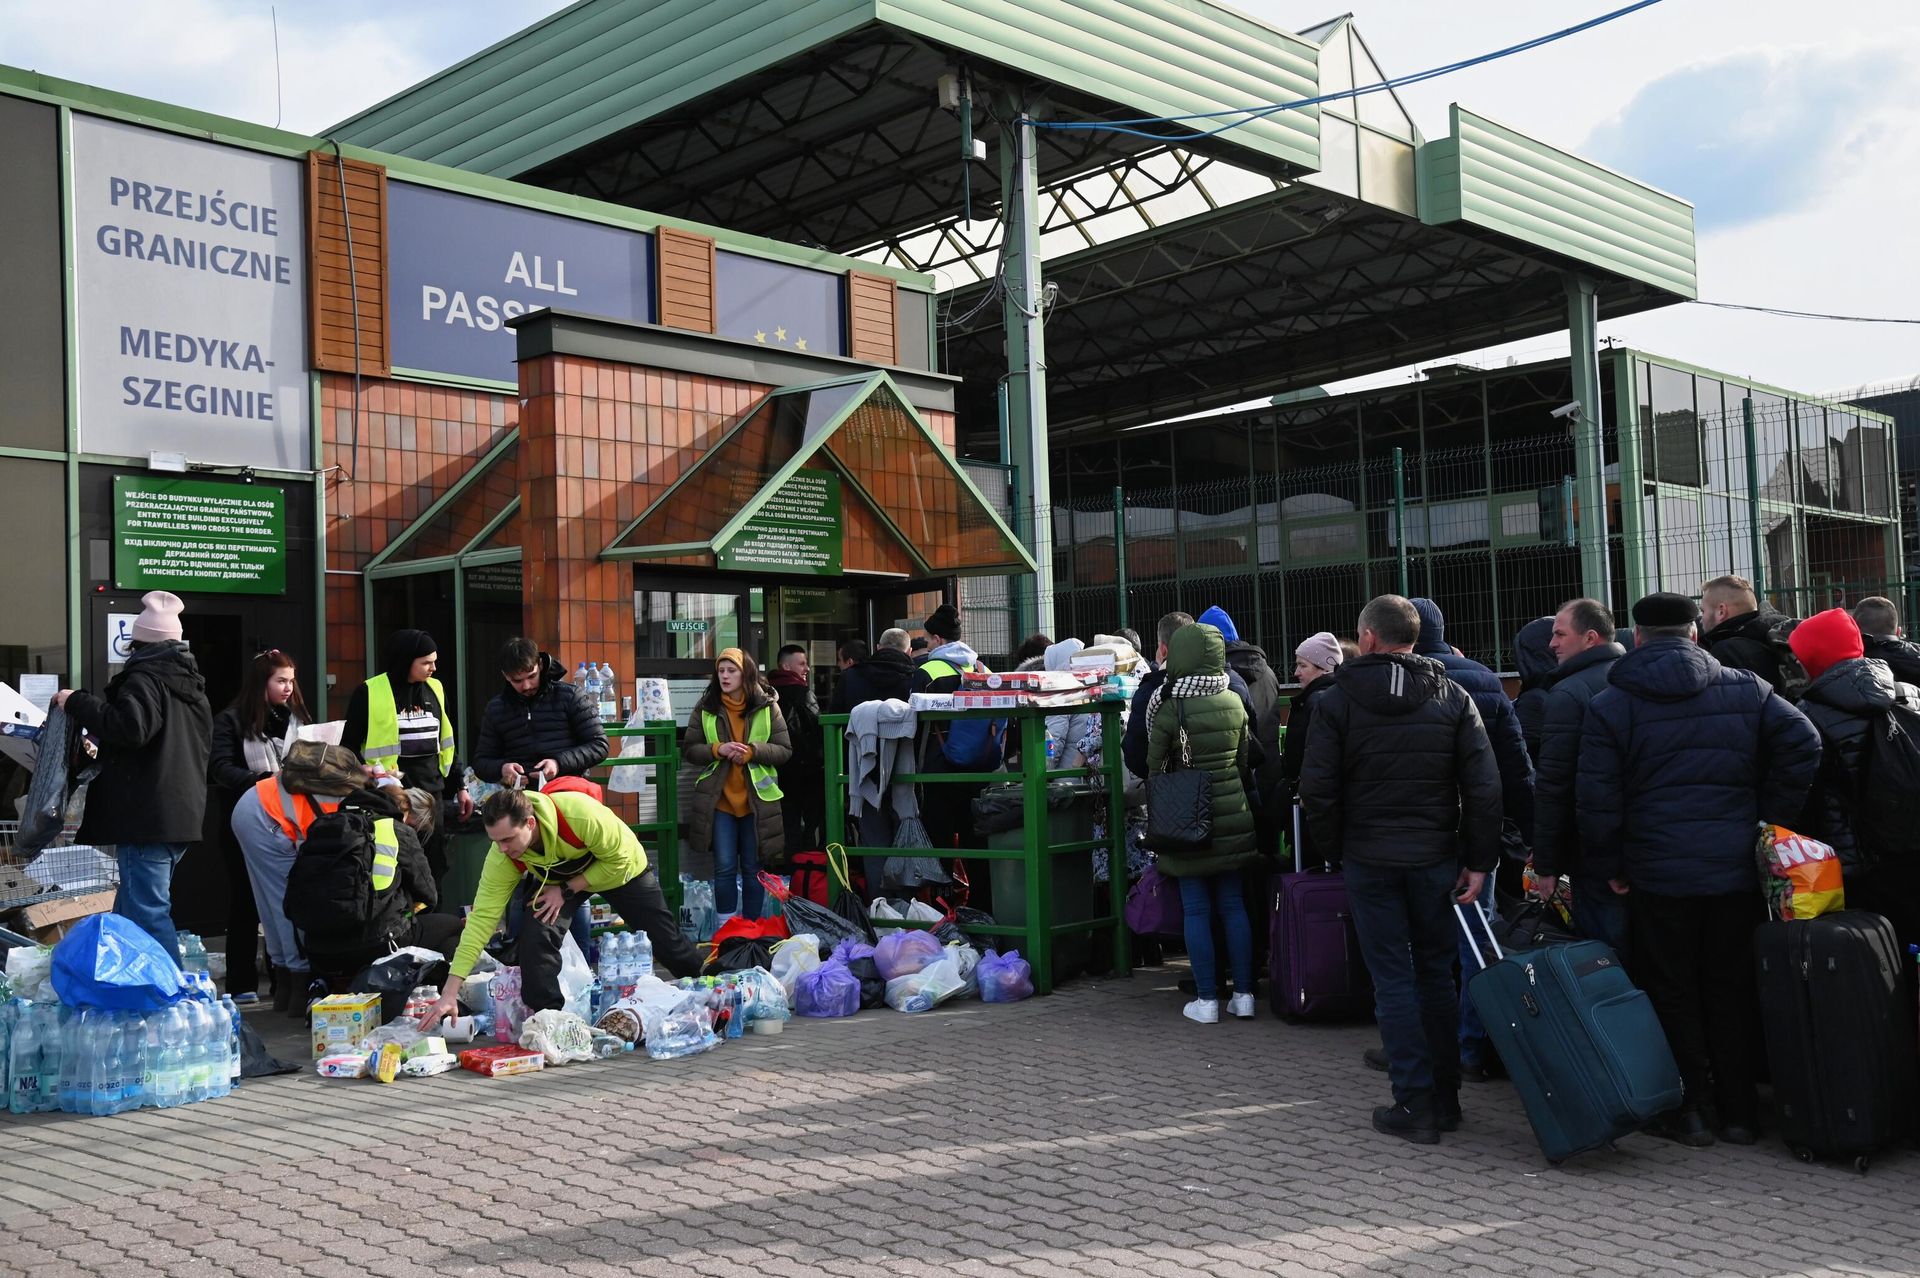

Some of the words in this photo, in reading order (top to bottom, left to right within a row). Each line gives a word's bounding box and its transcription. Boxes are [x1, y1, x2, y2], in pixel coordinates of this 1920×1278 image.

[109, 176, 279, 237] PRZEJŚCIE
[96, 223, 291, 286] GRANICZNE
[504, 251, 578, 296] ALL
[422, 285, 547, 336] PASS
[120, 326, 276, 374] MEDYKA-
[121, 375, 275, 422] SZEGINIE
[125, 490, 156, 500] WEJŚCIE
[169, 494, 202, 503] BUDYNKU
[203, 497, 242, 506] WYŁĄCZNIE
[257, 499, 274, 508] OSÓB
[126, 501, 198, 512] PRZEKRACZAJĄCYCH
[199, 506, 229, 515] GRANICĘ
[188, 514, 220, 523] BUILDING
[221, 516, 264, 525] EXCLUSIVELY
[143, 521, 190, 530] TRAWELLERS
[245, 527, 274, 535] BORDER.
[124, 538, 142, 546] ВХІД
[165, 550, 210, 558] ДЕРЖАВНИЙ
[162, 559, 188, 568] БУДУТЬ
[671, 620, 705, 630] WEJŚCIE
